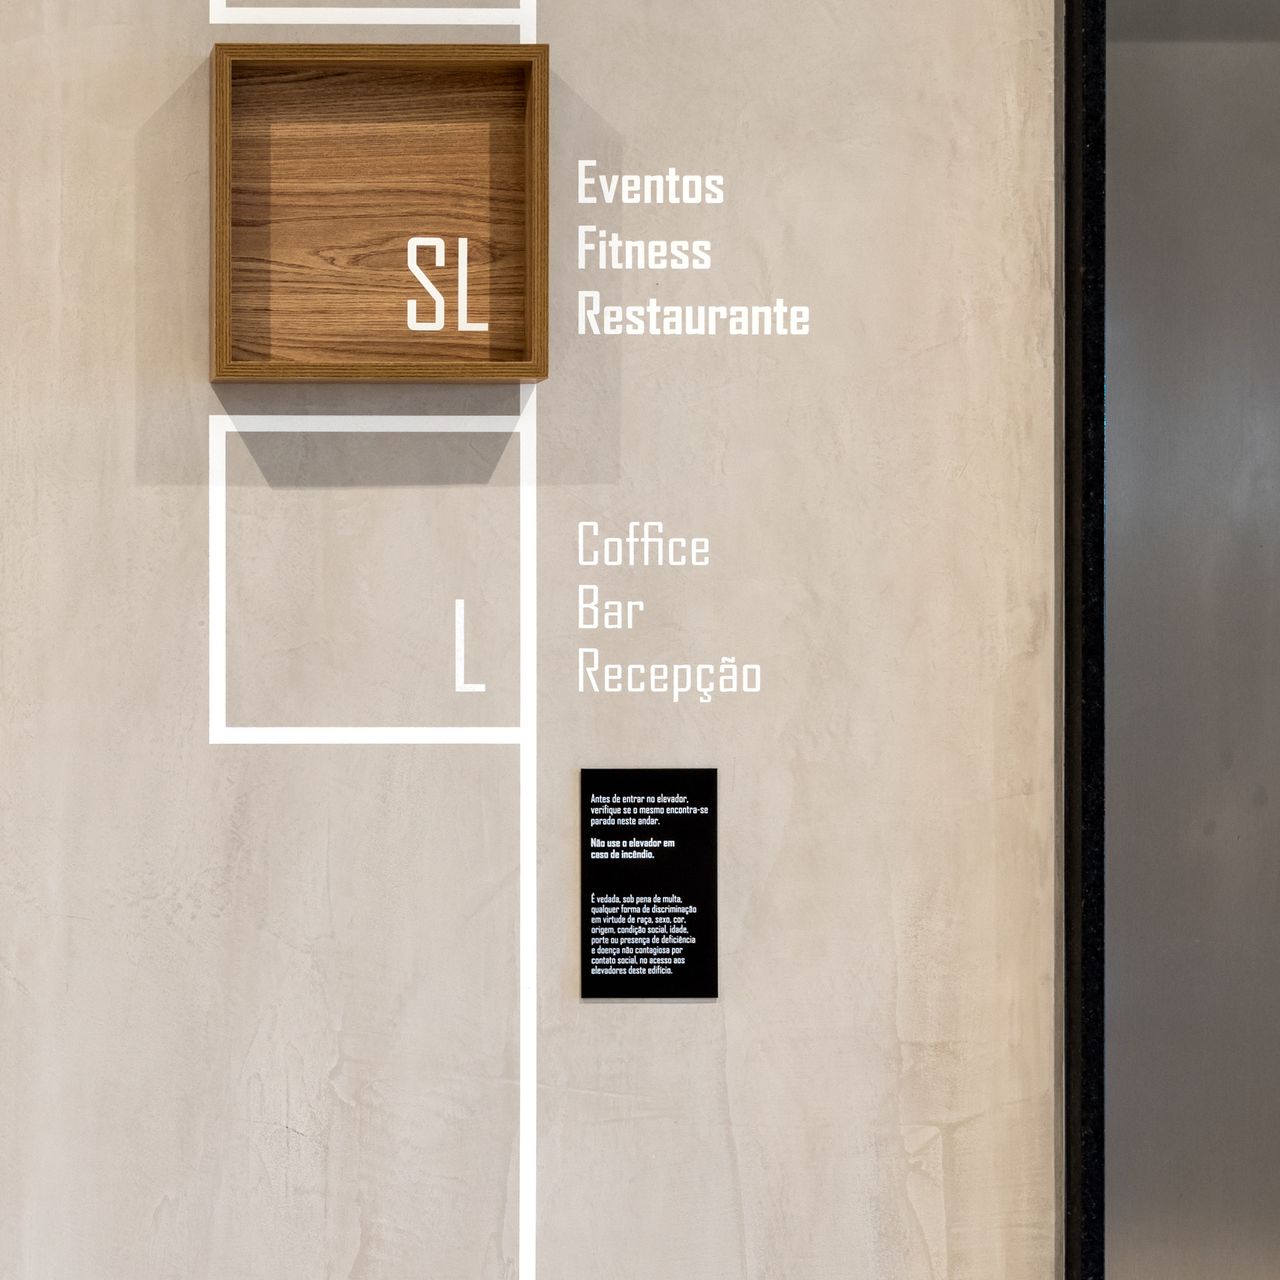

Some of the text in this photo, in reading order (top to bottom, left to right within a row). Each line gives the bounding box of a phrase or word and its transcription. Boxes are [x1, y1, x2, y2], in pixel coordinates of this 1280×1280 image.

[577, 159, 724, 204] Eventos
[577, 225, 712, 270] Fitness
[406, 236, 489, 332] SL
[577, 290, 810, 336] Restaurante
[577, 521, 710, 566] Coffice
[578, 584, 645, 629] Bar
[454, 598, 486, 693] L
[578, 647, 761, 703] Recepção
[591, 794, 610, 803] Antes
[612, 794, 620, 803] de
[622, 795, 645, 803] entrar
[591, 805, 621, 815] verifique
[666, 806, 708, 814] encontra-se
[591, 816, 615, 826] parado
[617, 817, 636, 825] neste
[591, 838, 605, 847] Não
[629, 838, 662, 847] elevador
[610, 849, 619, 858] de
[591, 893, 595, 903] É
[623, 894, 634, 903] sob
[653, 894, 661, 903] de
[591, 904, 697, 914] qualquer forma de discriminação
[603, 915, 625, 923] virtude
[627, 915, 635, 923] de
[617, 925, 646, 935] condição
[591, 936, 609, 945] porte
[652, 935, 659, 943] de
[661, 935, 696, 943] deficiência
[597, 946, 620, 955] doença
[635, 946, 670, 955] contagiosa
[591, 966, 627, 974] elevadores
[628, 966, 646, 974] deste
